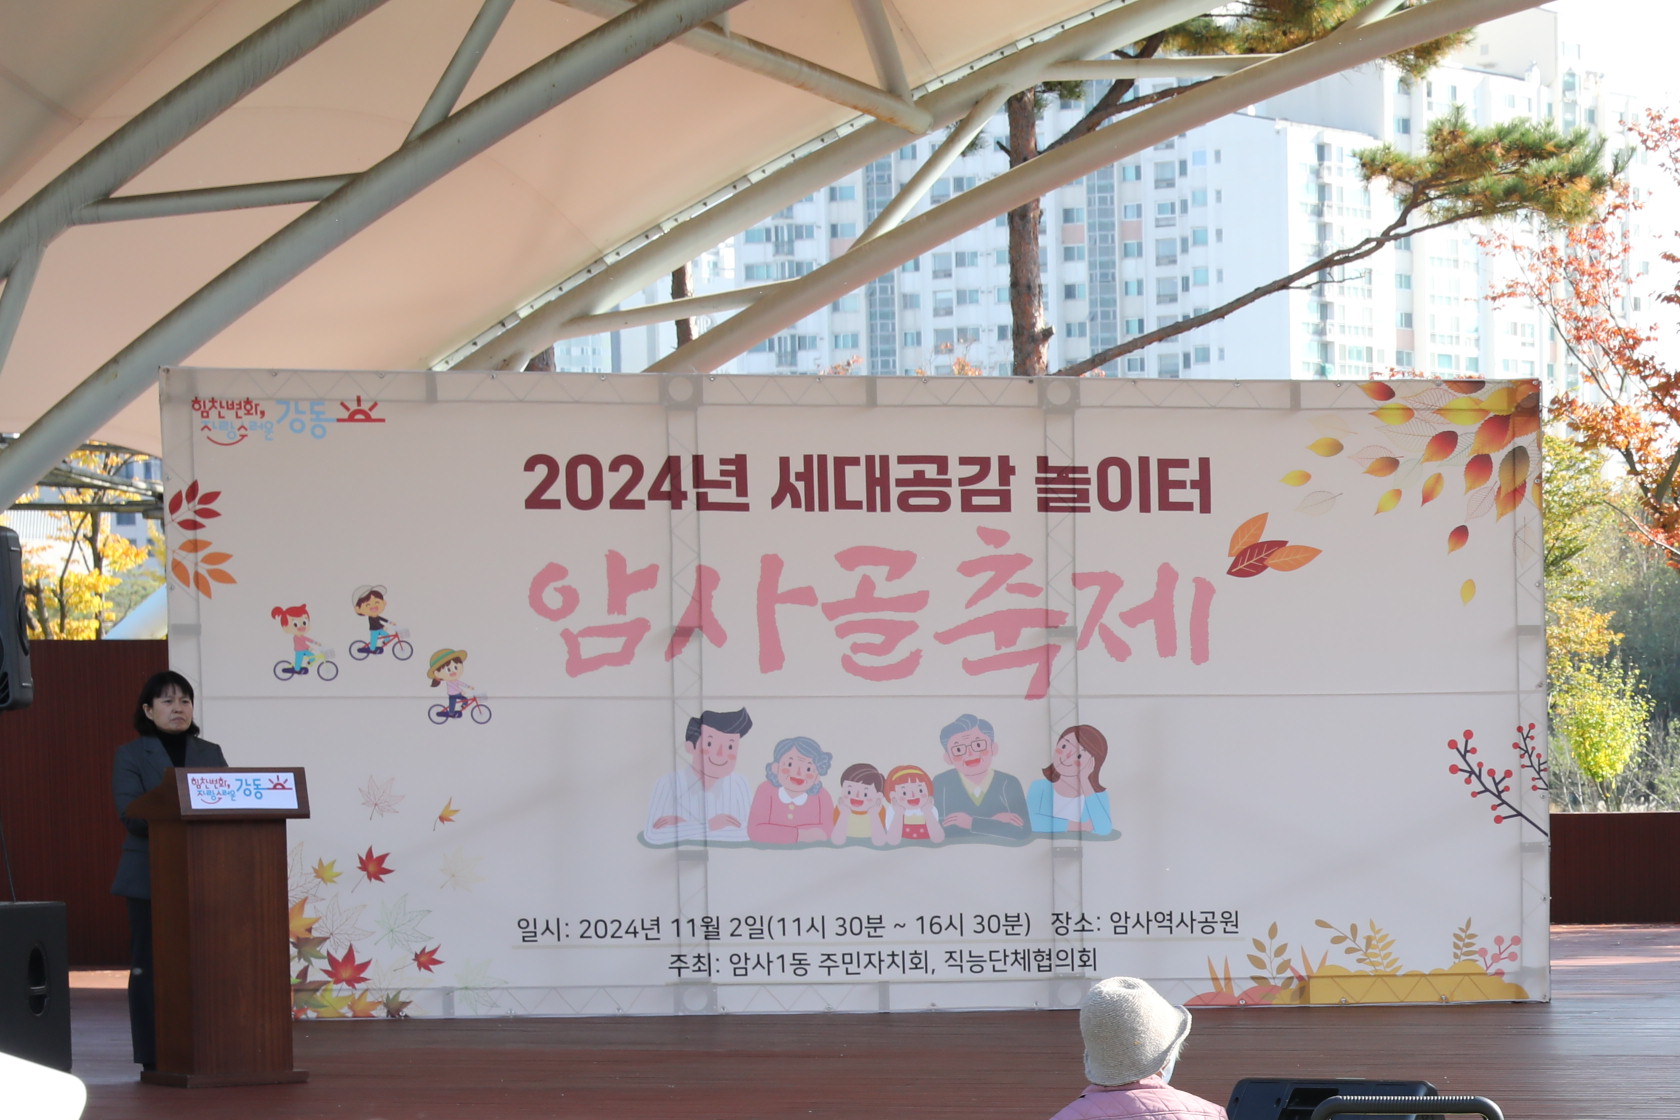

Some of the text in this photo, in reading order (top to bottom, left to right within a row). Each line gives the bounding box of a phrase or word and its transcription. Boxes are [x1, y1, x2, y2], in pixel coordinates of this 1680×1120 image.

[200, 419, 274, 442] 자랑스러운
[275, 400, 332, 440] 강동
[524, 454, 1211, 514] 2024년 세대공감 놀이터
[196, 789, 237, 802] 자랑스러운
[235, 778, 265, 800] 강동
[517, 917, 570, 943] 일시:
[579, 916, 661, 941] 2024년
[671, 915, 721, 941] 11월
[835, 914, 886, 939] 30분
[916, 912, 964, 937] 16시
[973, 912, 1031, 937] 30분)
[1051, 911, 1101, 937] 장소:
[1110, 910, 1240, 936] 암사역사공원
[668, 947, 1098, 978] 주최: 암사1동 주민자치회, 직능단체협의회
